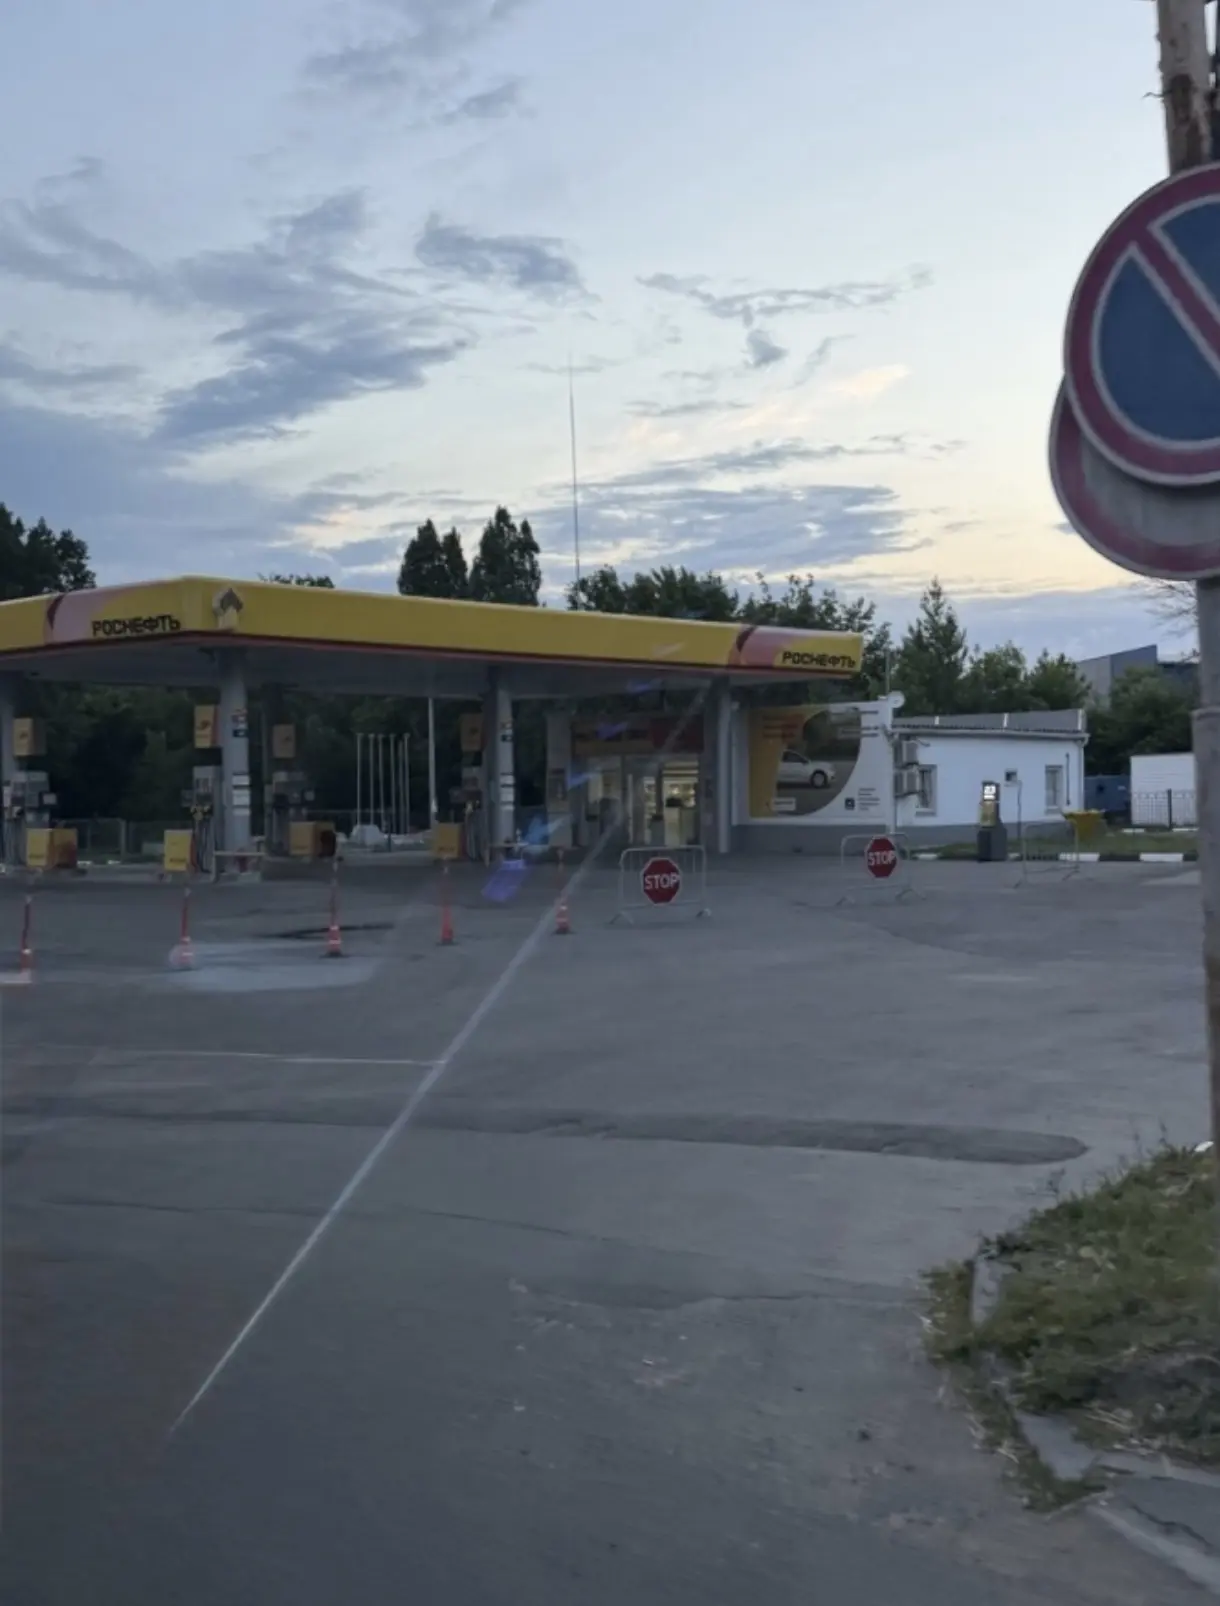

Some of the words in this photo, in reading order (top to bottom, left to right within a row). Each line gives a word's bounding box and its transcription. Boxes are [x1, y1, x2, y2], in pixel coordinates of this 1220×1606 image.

[92, 614, 181, 637] РОСНЕФТЬ
[782, 651, 857, 669] РОСНЕФТЬ
[868, 850, 895, 866] STOP
[644, 872, 680, 890] STOP
